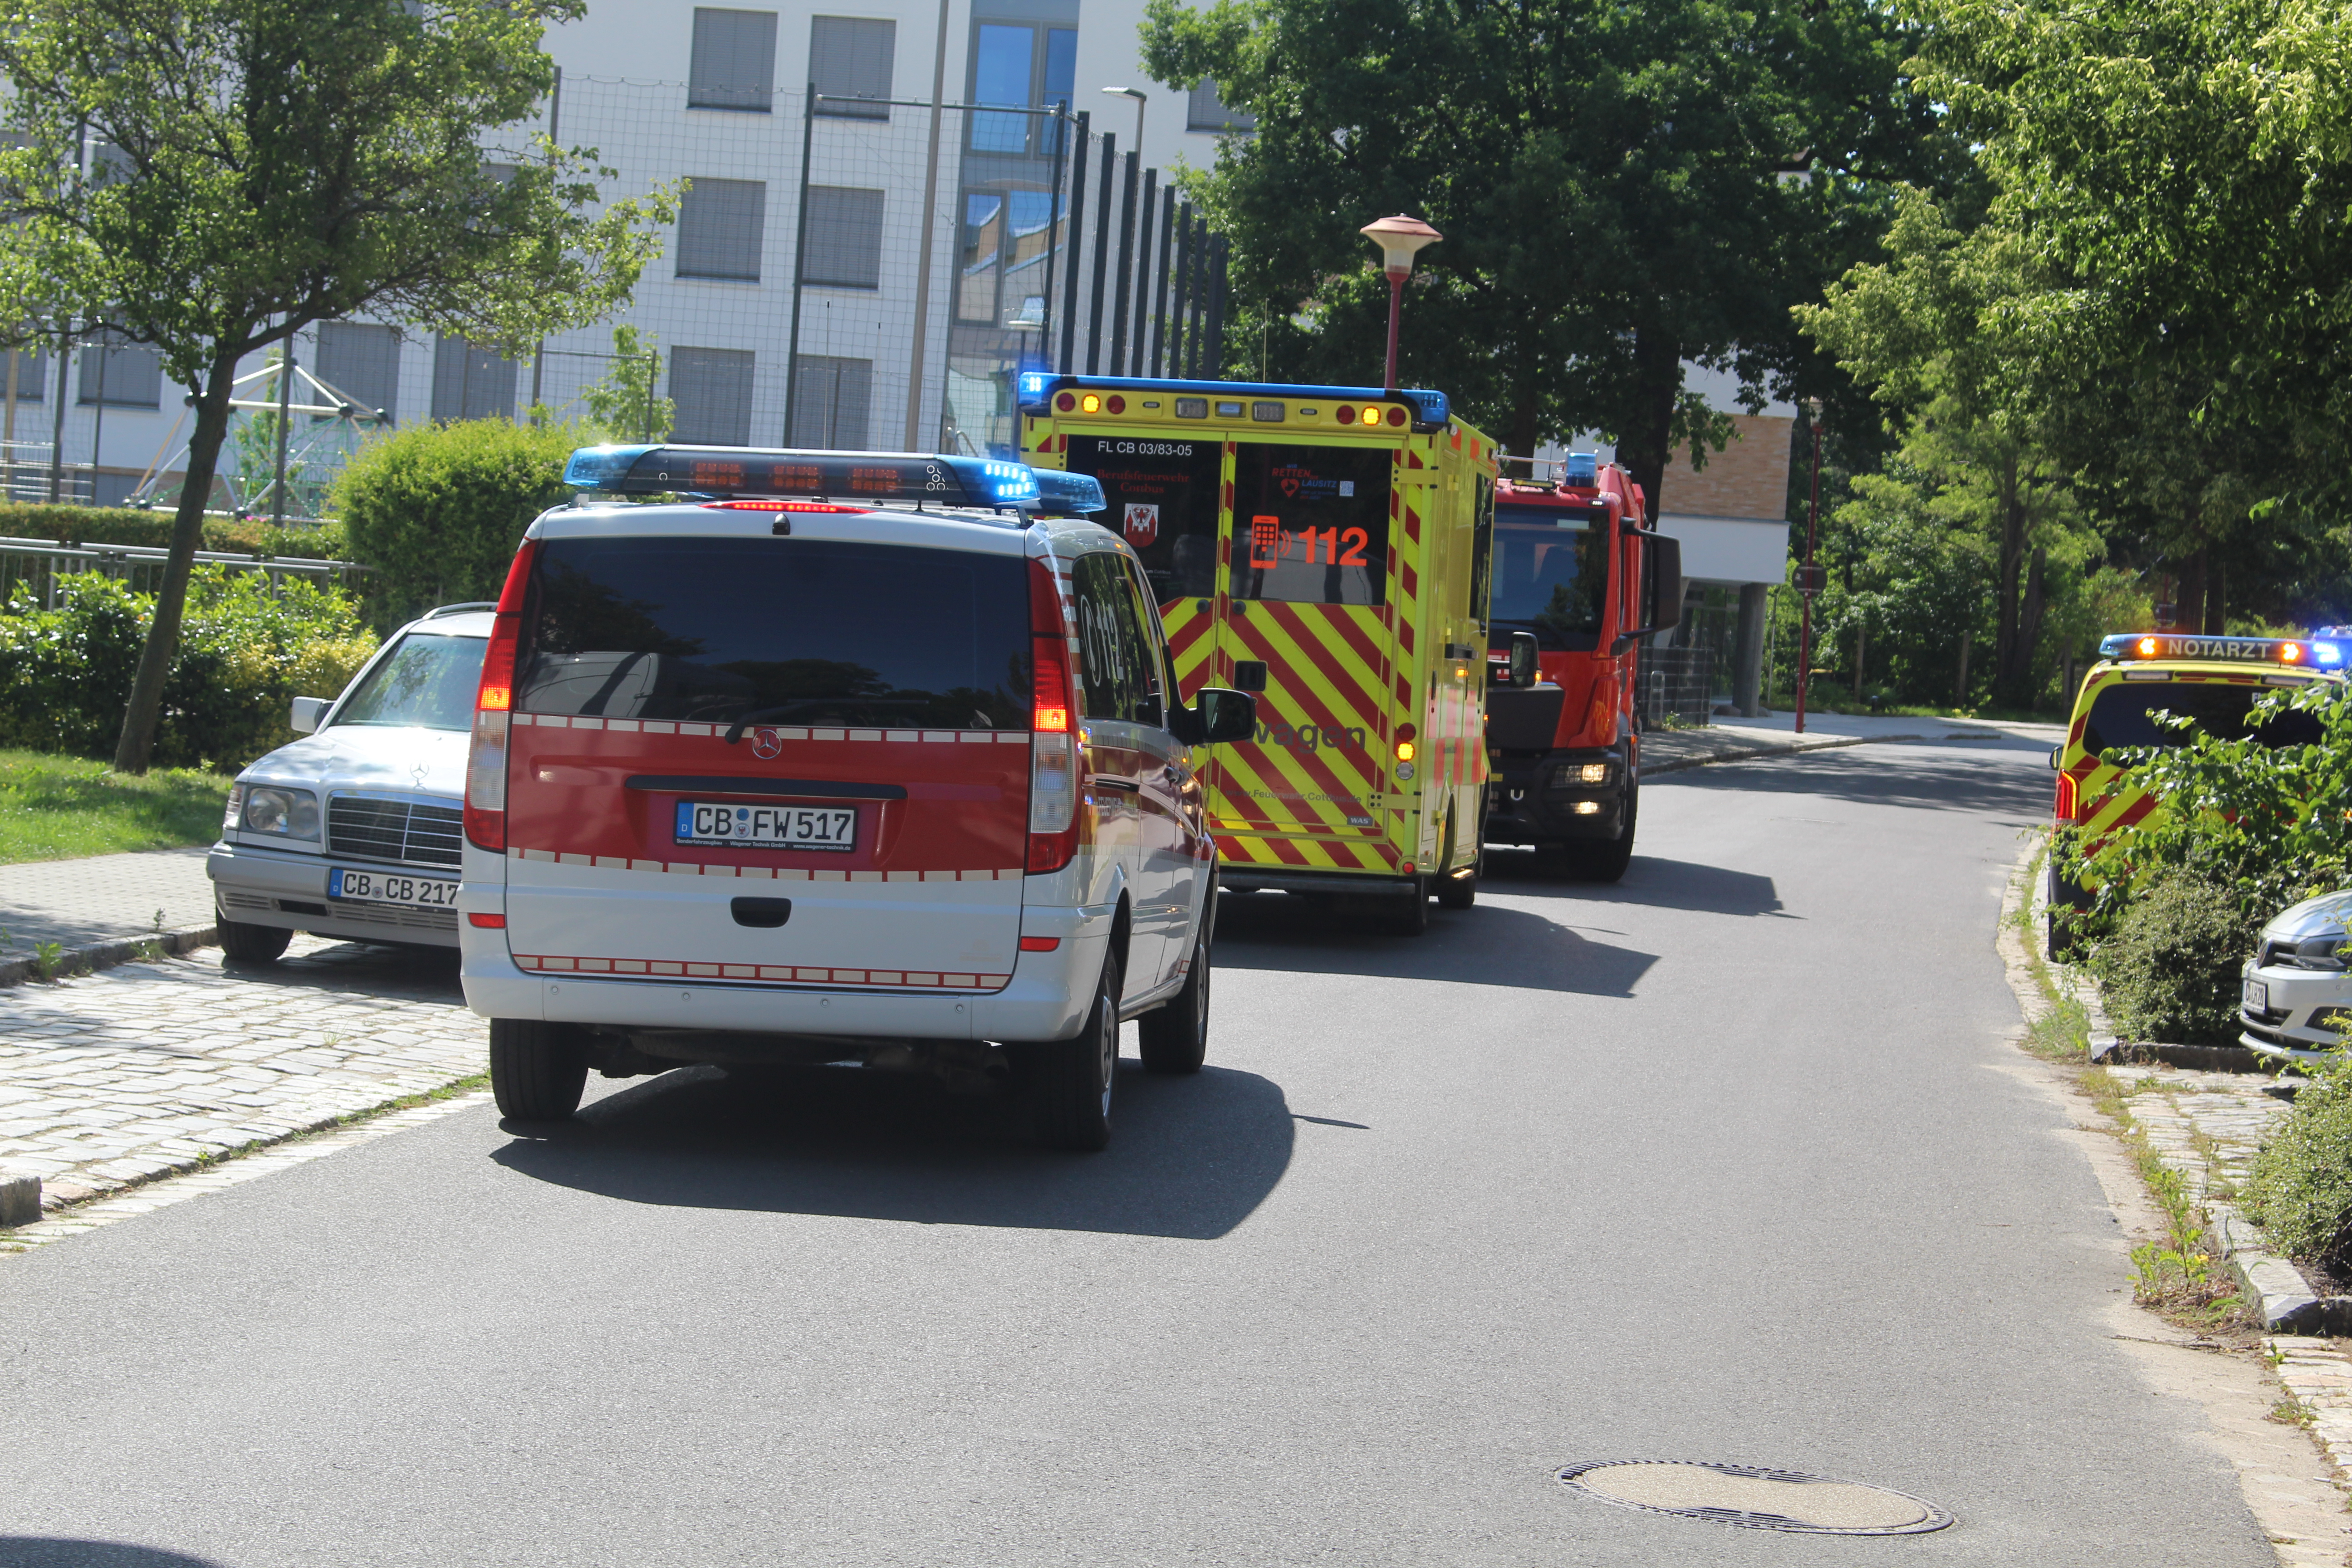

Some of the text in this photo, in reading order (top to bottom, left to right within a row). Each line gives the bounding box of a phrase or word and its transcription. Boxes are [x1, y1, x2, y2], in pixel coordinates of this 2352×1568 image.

[1098, 441, 1192, 456] FL CB 03/83-05
[1097, 469, 1190, 483] Berufsfeuerwehr
[1272, 468, 1311, 477] RETTEN
[1120, 482, 1165, 493] Cottbus
[1302, 480, 1337, 488] LAUSITZ
[1298, 525, 1368, 567] 112
[1096, 602, 1124, 680] 112
[2169, 639, 2270, 658] NOTARZT
[1245, 722, 1366, 754] wagen
[1225, 789, 1362, 804] www.Feuerwehr.Cottbus.de
[681, 823, 687, 832] D
[695, 807, 851, 841] CB FW 517
[343, 873, 458, 905] CB CB 217
